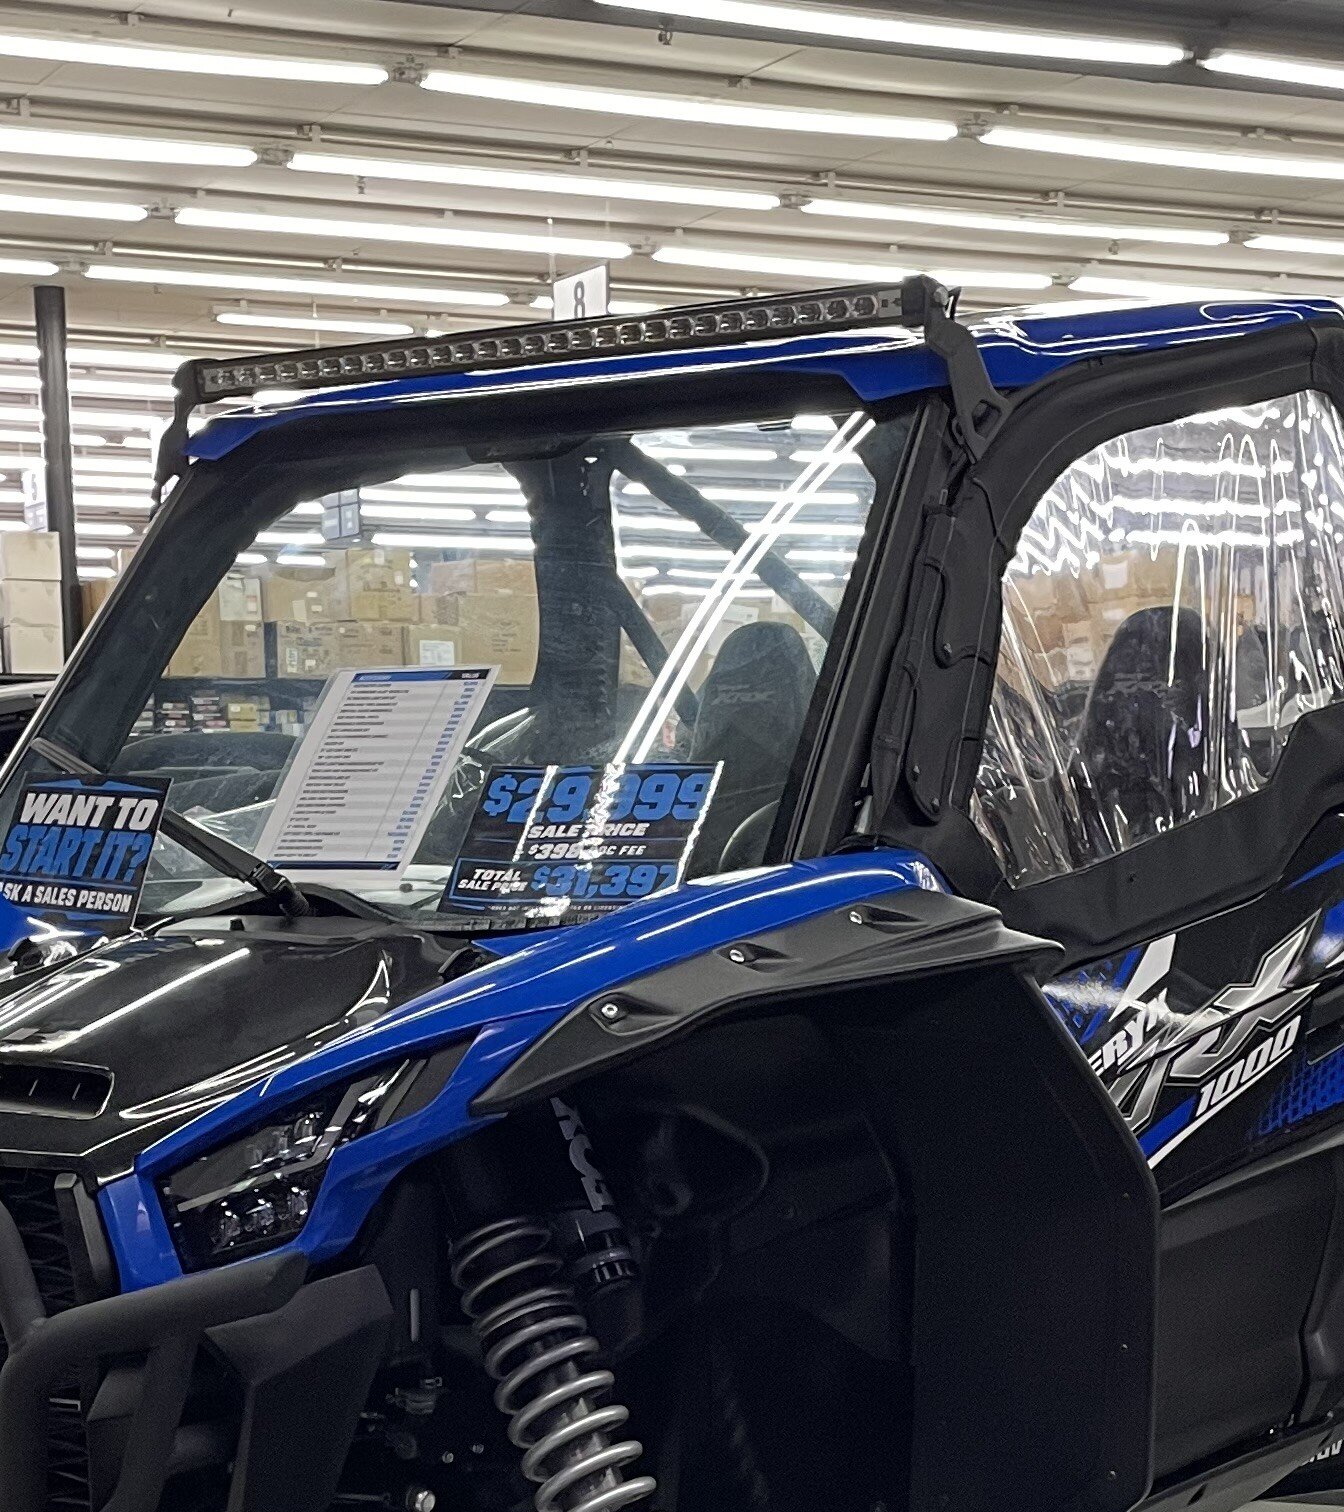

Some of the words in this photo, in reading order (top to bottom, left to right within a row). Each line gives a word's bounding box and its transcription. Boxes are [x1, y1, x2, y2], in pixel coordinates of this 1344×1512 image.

[573, 280, 586, 319] 8
[19, 792, 116, 828] WANT
[113, 797, 159, 831] TO
[527, 824, 583, 839] SALE
[91, 830, 153, 883] IT?
[618, 844, 647, 856] FEE
[457, 878, 492, 891] SALE
[471, 867, 523, 882] TOTAL
[21, 885, 33, 902] A
[33, 885, 77, 907] SALES
[76, 889, 133, 914] PERSON
[1195, 1014, 1302, 1118] 1000
